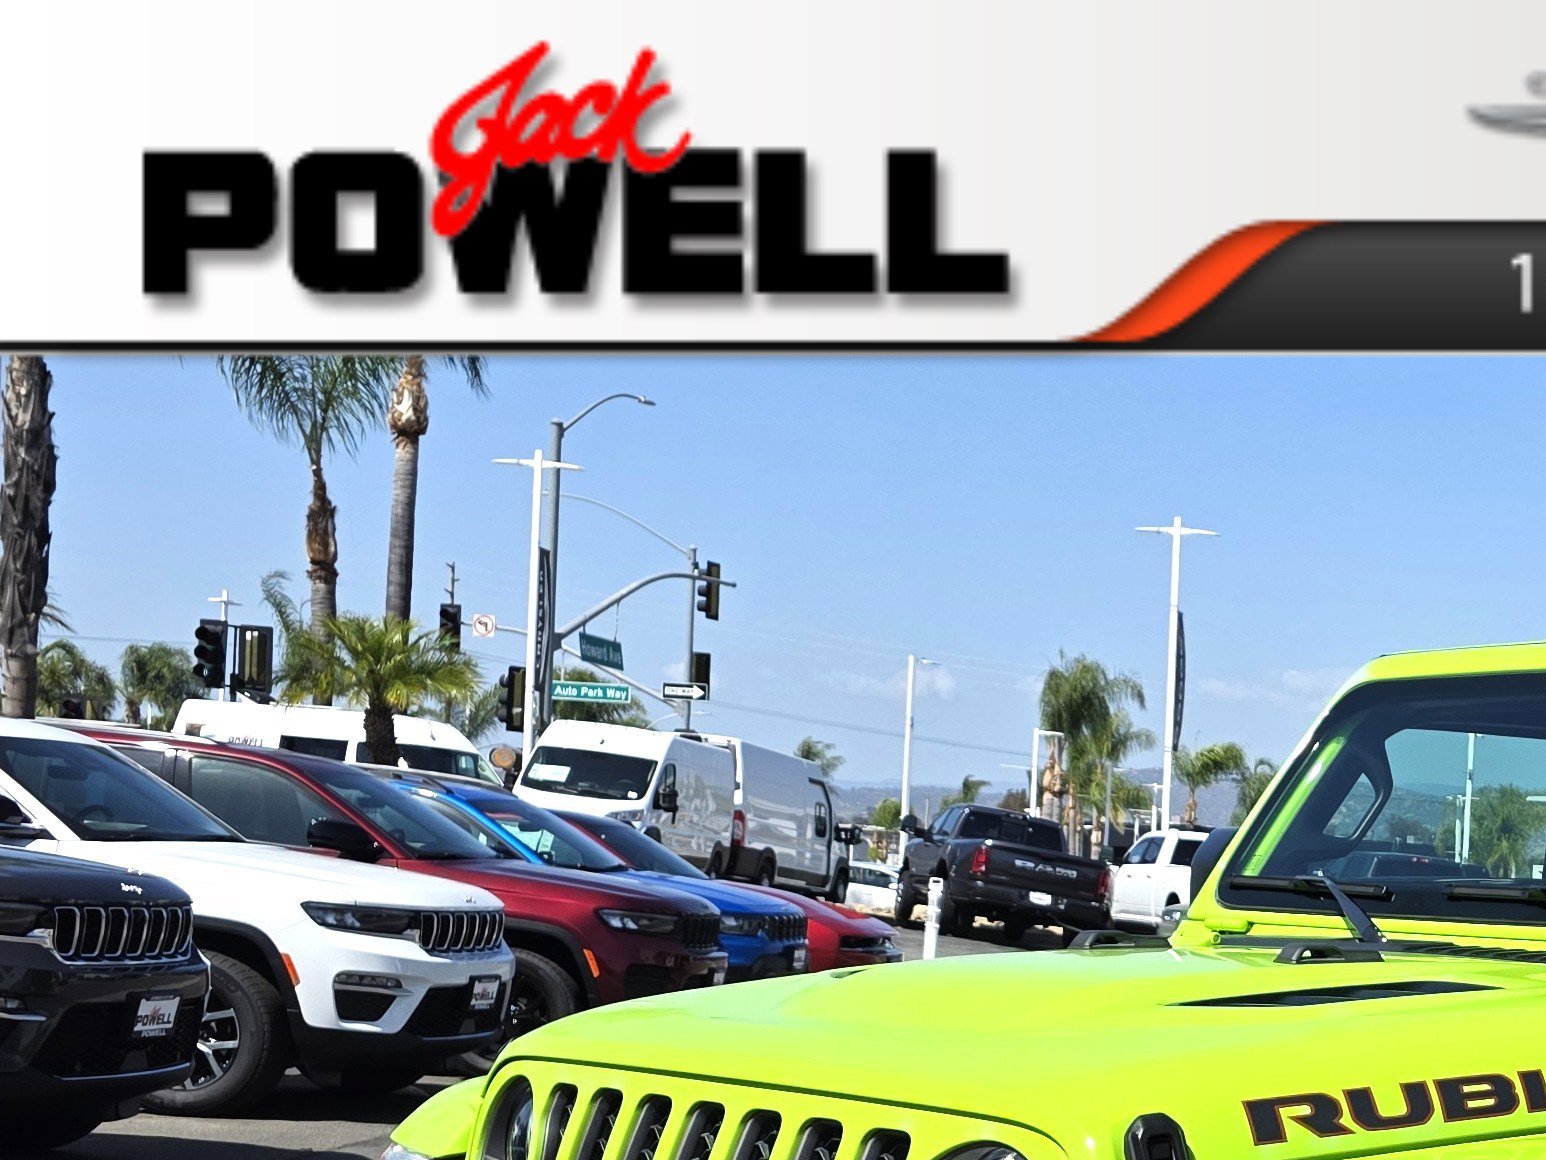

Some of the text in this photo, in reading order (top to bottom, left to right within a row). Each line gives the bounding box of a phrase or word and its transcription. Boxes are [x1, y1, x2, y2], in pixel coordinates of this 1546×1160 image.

[580, 638, 622, 664] Howard Ave
[554, 685, 627, 700] Auto Park Way
[135, 1013, 172, 1027] POWELL
